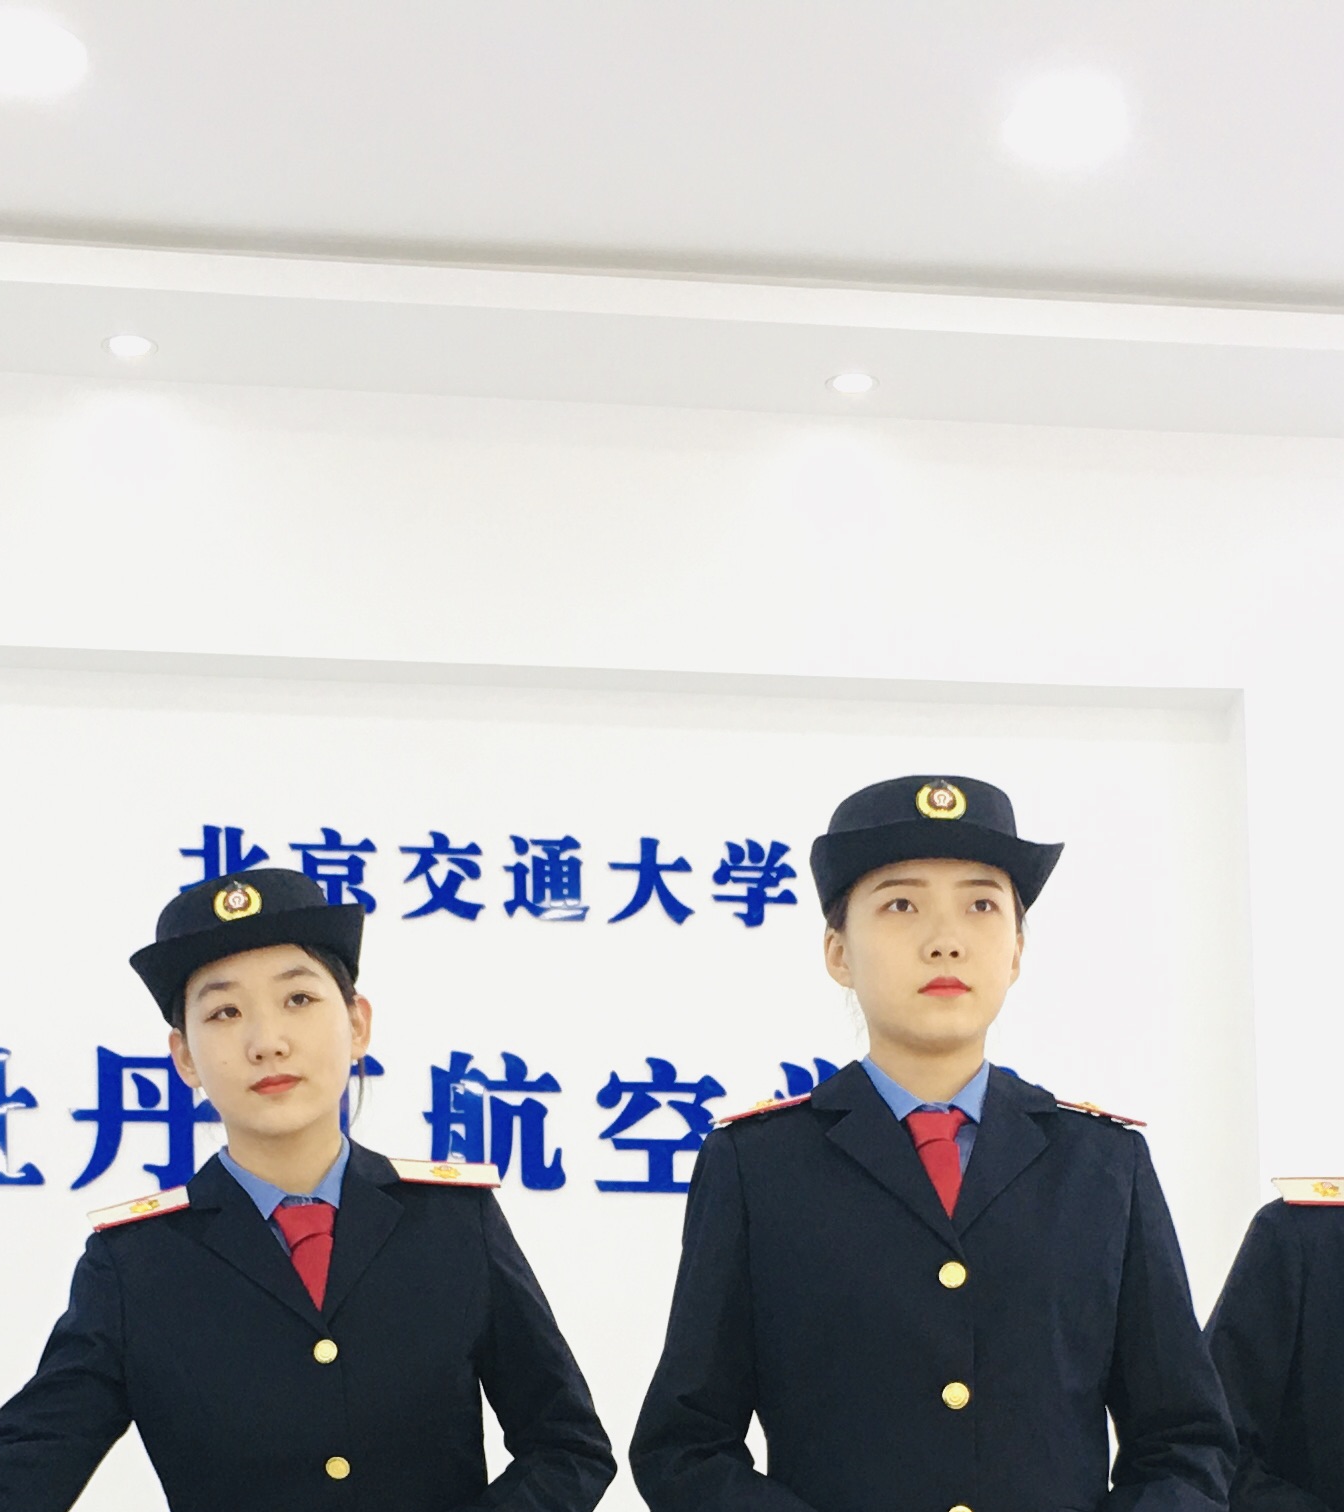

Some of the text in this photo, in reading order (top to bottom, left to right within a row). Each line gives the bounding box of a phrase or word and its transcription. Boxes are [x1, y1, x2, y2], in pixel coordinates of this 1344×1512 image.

[179, 823, 798, 927] 北京交通大学
